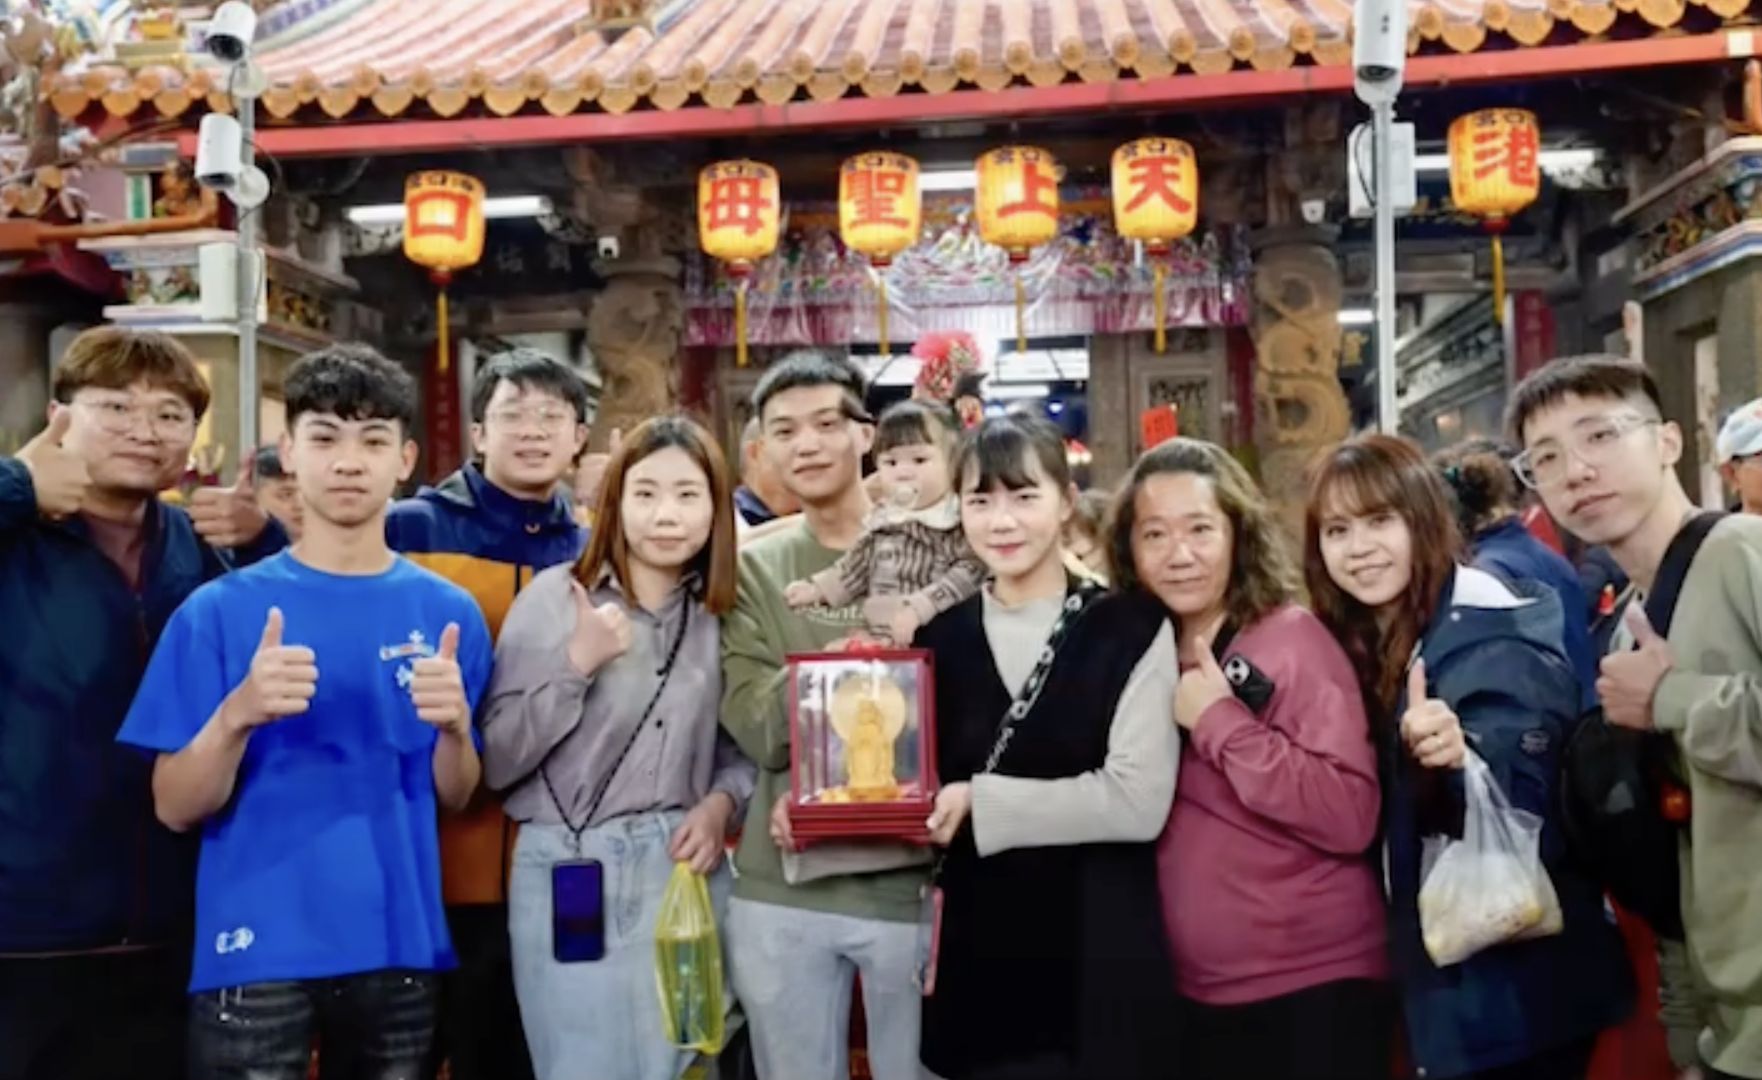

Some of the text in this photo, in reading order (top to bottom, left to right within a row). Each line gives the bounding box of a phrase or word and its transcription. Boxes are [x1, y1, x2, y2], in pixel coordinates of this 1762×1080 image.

[1472, 123, 1537, 187] 港
[704, 178, 771, 236] 母
[846, 169, 910, 229] 聖
[997, 162, 1058, 218] 上
[1124, 157, 1191, 214] 天
[408, 191, 471, 241] 口
